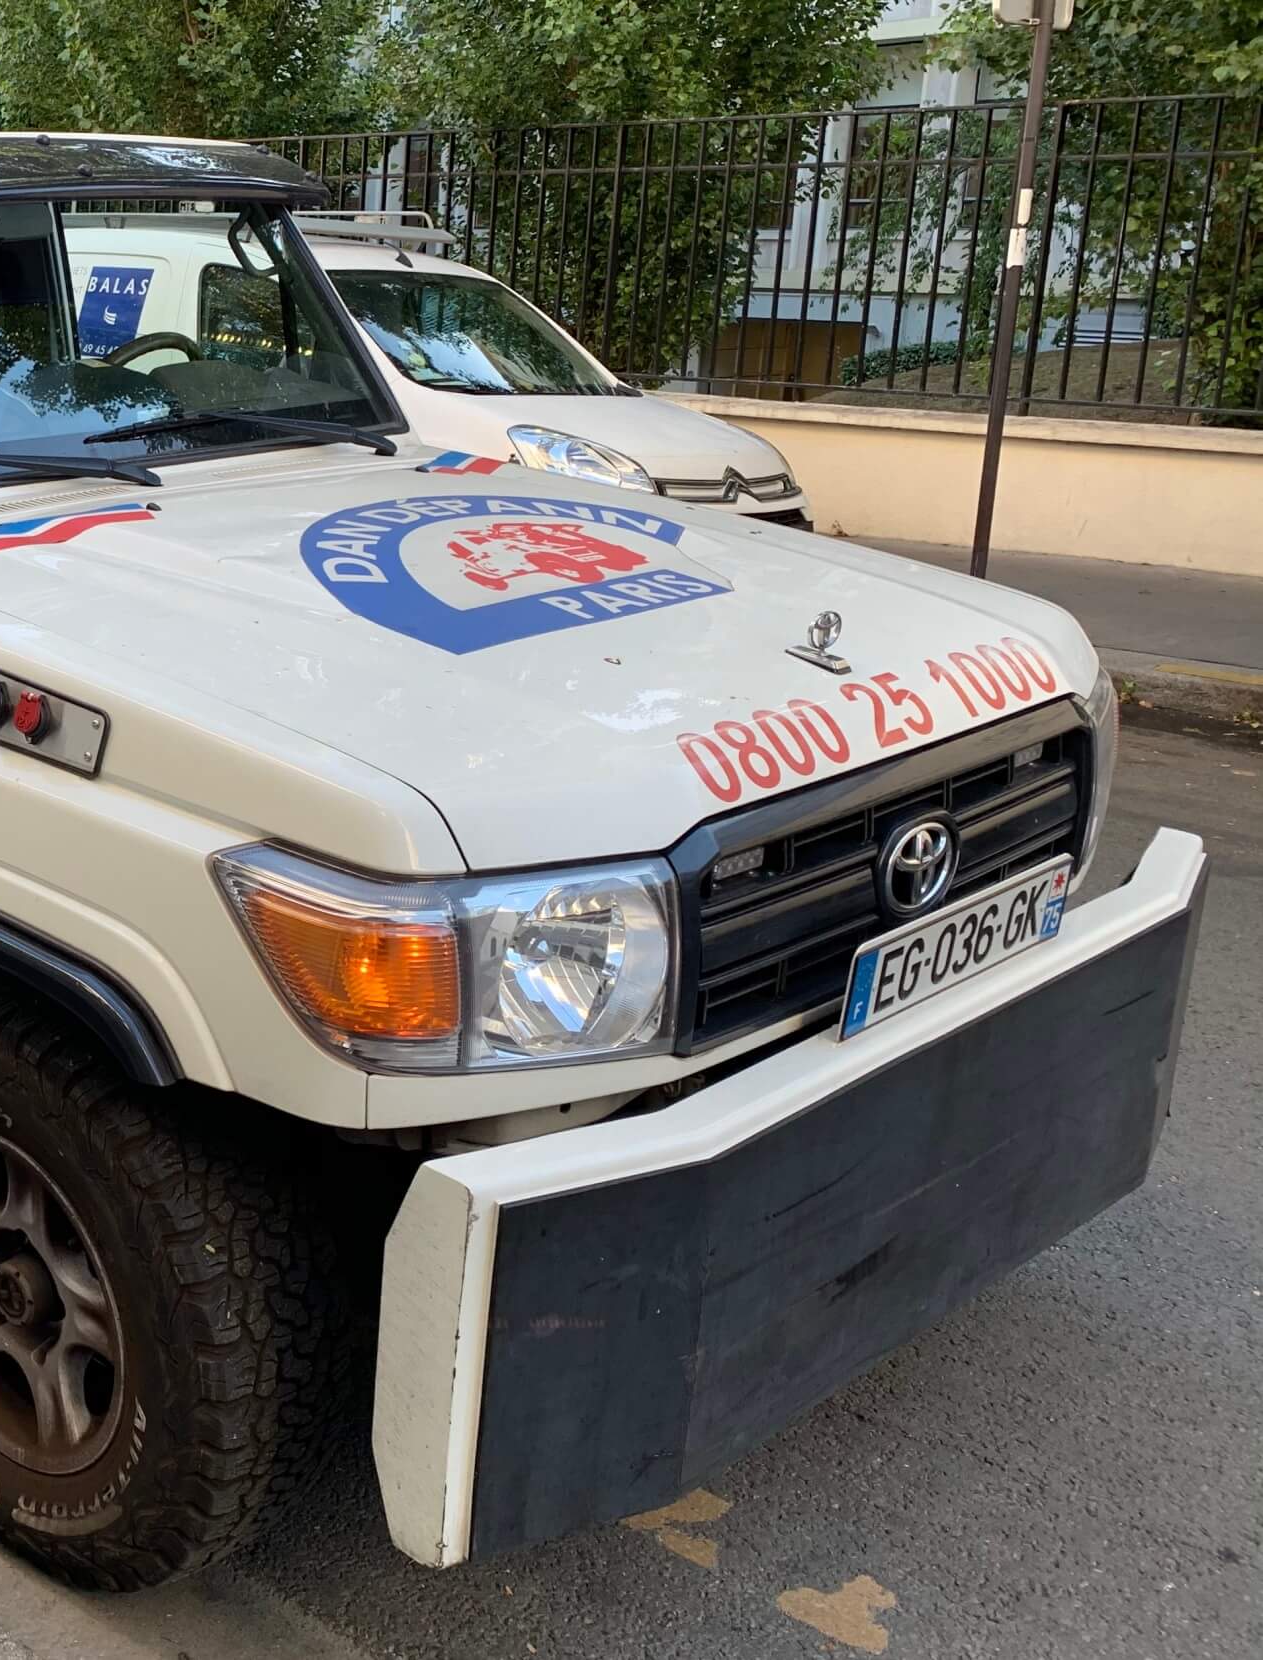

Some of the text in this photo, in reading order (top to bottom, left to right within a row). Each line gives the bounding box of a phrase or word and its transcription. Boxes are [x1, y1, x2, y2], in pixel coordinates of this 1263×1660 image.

[88, 276, 149, 295] BALAS
[541, 571, 714, 619] PARIS
[676, 636, 1058, 804] 0800 25 1000
[853, 879, 1062, 1020] F EG-036-GK 75
